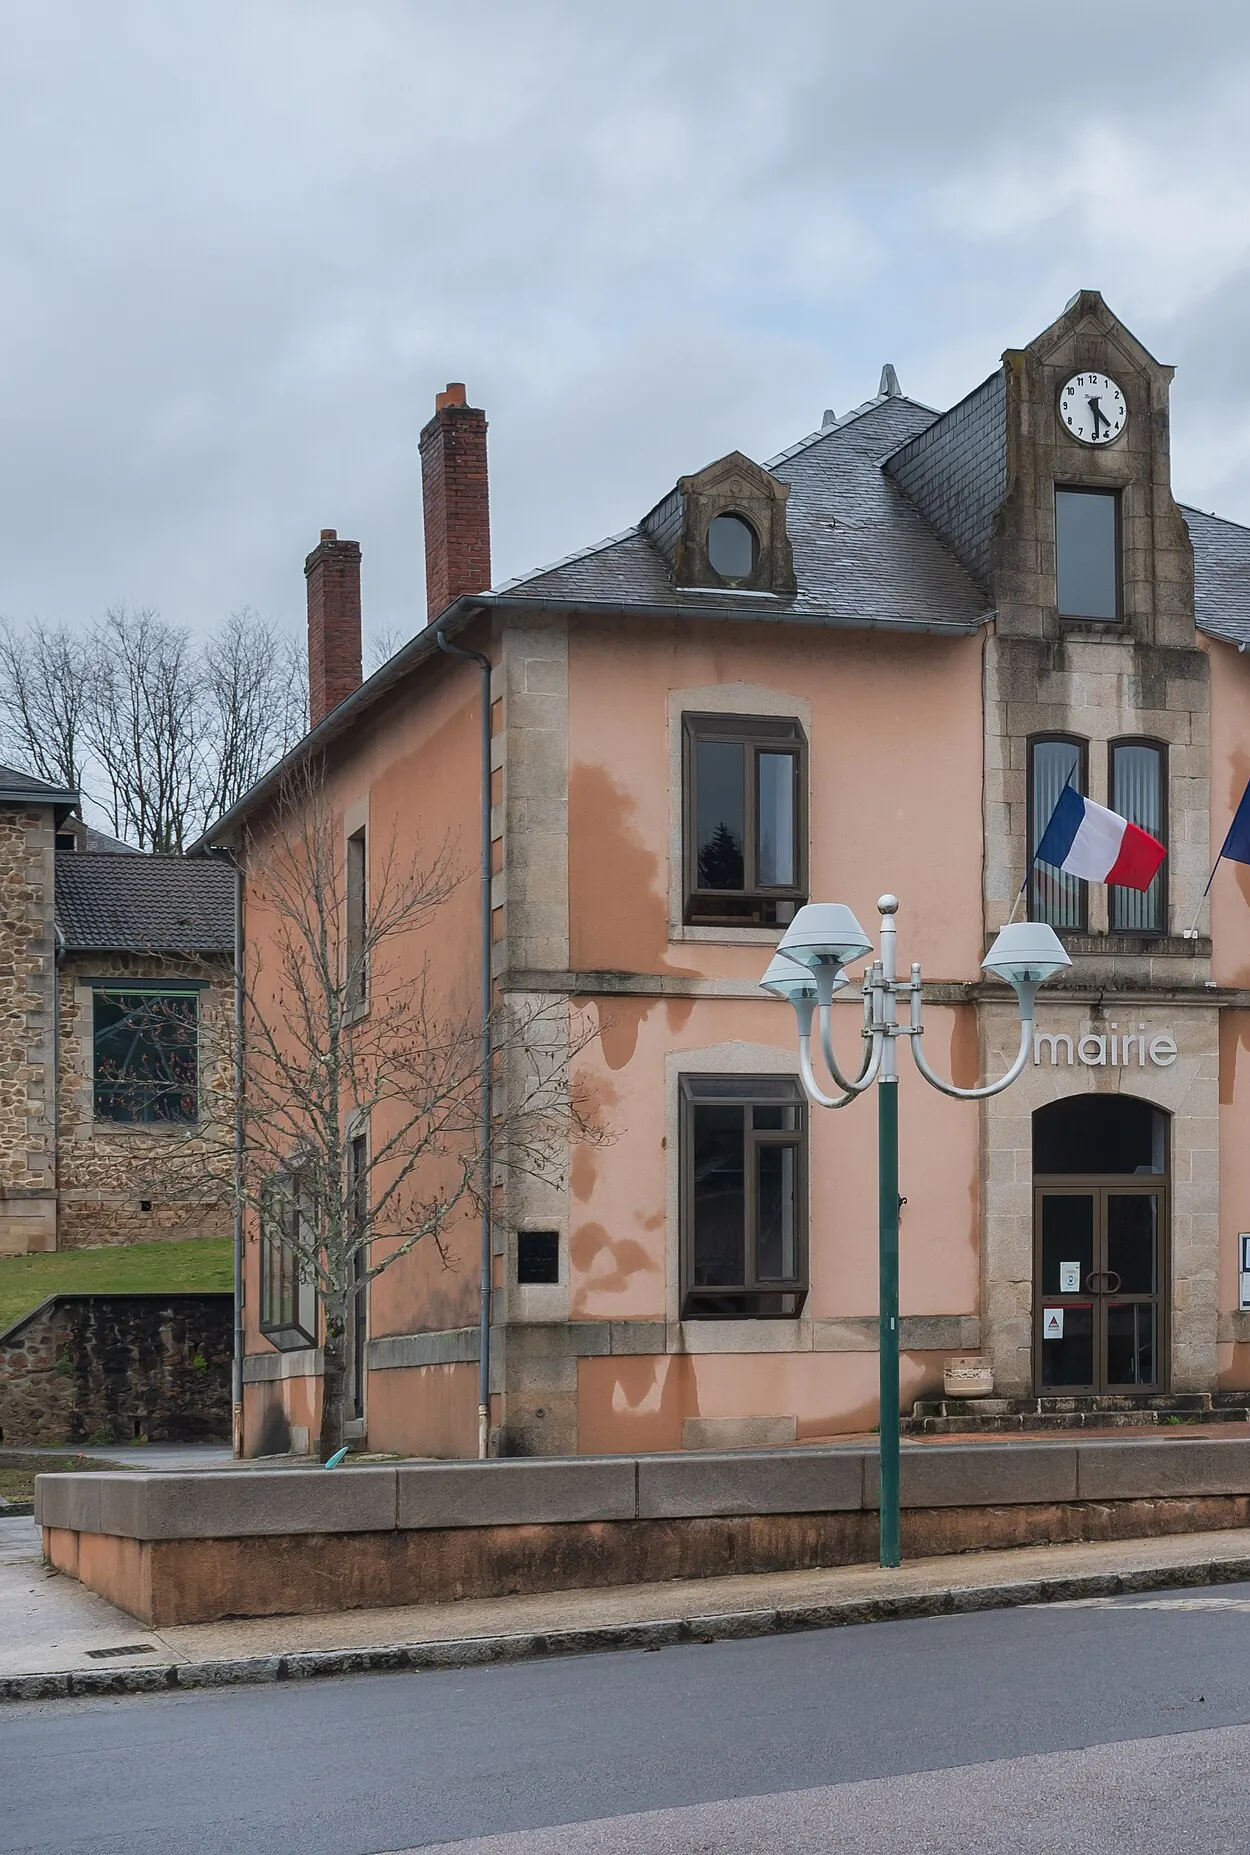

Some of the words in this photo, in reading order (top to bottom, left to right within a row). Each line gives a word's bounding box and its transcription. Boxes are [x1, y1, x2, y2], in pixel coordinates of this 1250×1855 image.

[1077, 377, 1084, 386] 11
[1088, 375, 1097, 384] 12
[1066, 387, 1075, 396] 10
[1114, 391, 1119, 399] 2
[1063, 402, 1068, 410] 9
[1119, 407, 1124, 415] 3
[1067, 417, 1072, 425] 8
[1114, 422, 1119, 430] 4
[1078, 428, 1083, 436] 7
[1103, 430, 1110, 439] 5
[1091, 433, 1097, 441] 6
[1034, 1023, 1177, 1066] mairie
